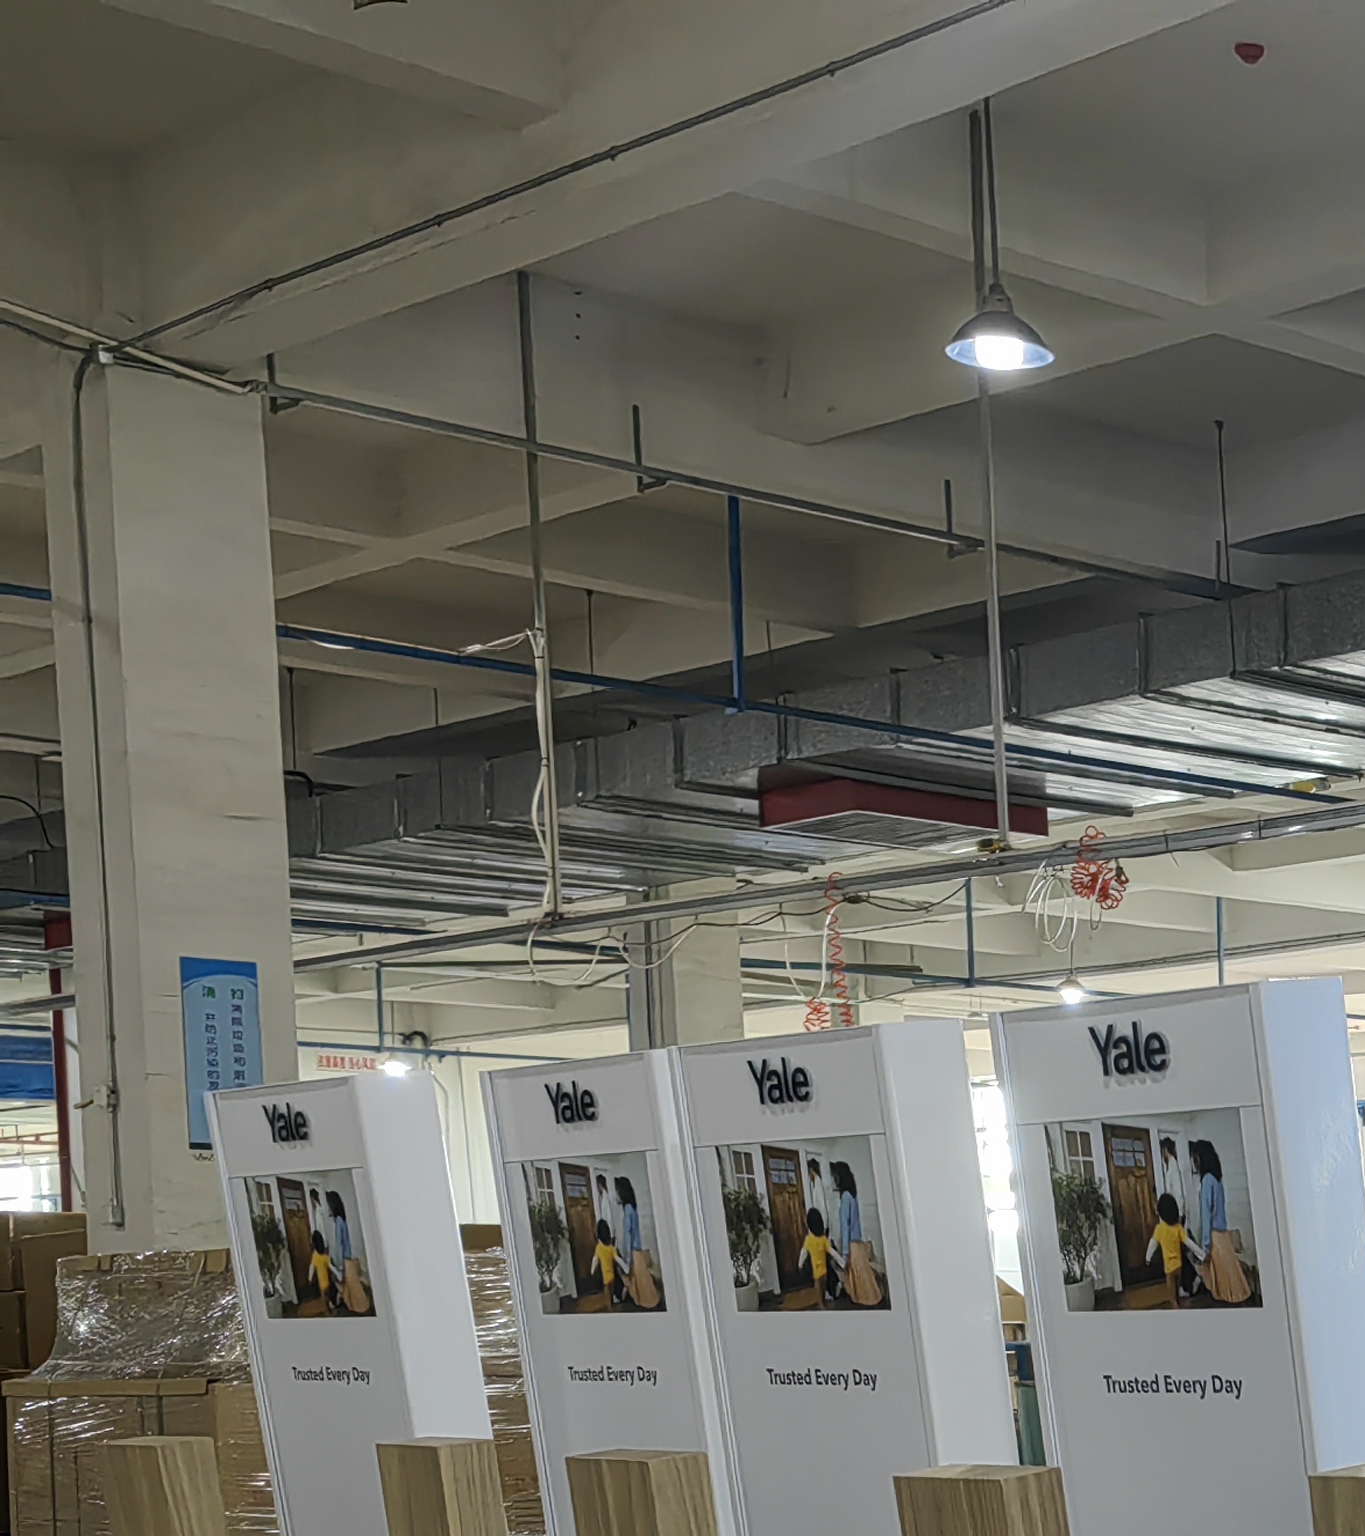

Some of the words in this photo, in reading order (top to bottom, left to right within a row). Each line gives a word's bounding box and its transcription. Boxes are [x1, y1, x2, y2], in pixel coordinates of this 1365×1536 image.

[1087, 1021, 1170, 1077] Yale
[747, 1056, 811, 1105] Yale
[545, 1080, 597, 1125] Yale
[262, 1102, 310, 1143] Yale
[292, 1367, 325, 1382] Trusted
[326, 1366, 350, 1386] Every
[351, 1366, 371, 1386] Day
[568, 1365, 605, 1382] Trusted
[606, 1366, 635, 1387] Every
[637, 1366, 657, 1387] Day
[766, 1367, 812, 1386] Trusted
[814, 1368, 849, 1392] Every
[852, 1368, 878, 1392] Day
[1102, 1373, 1160, 1394] Trusted
[1163, 1374, 1207, 1400] Every
[1210, 1374, 1243, 1400] Day
